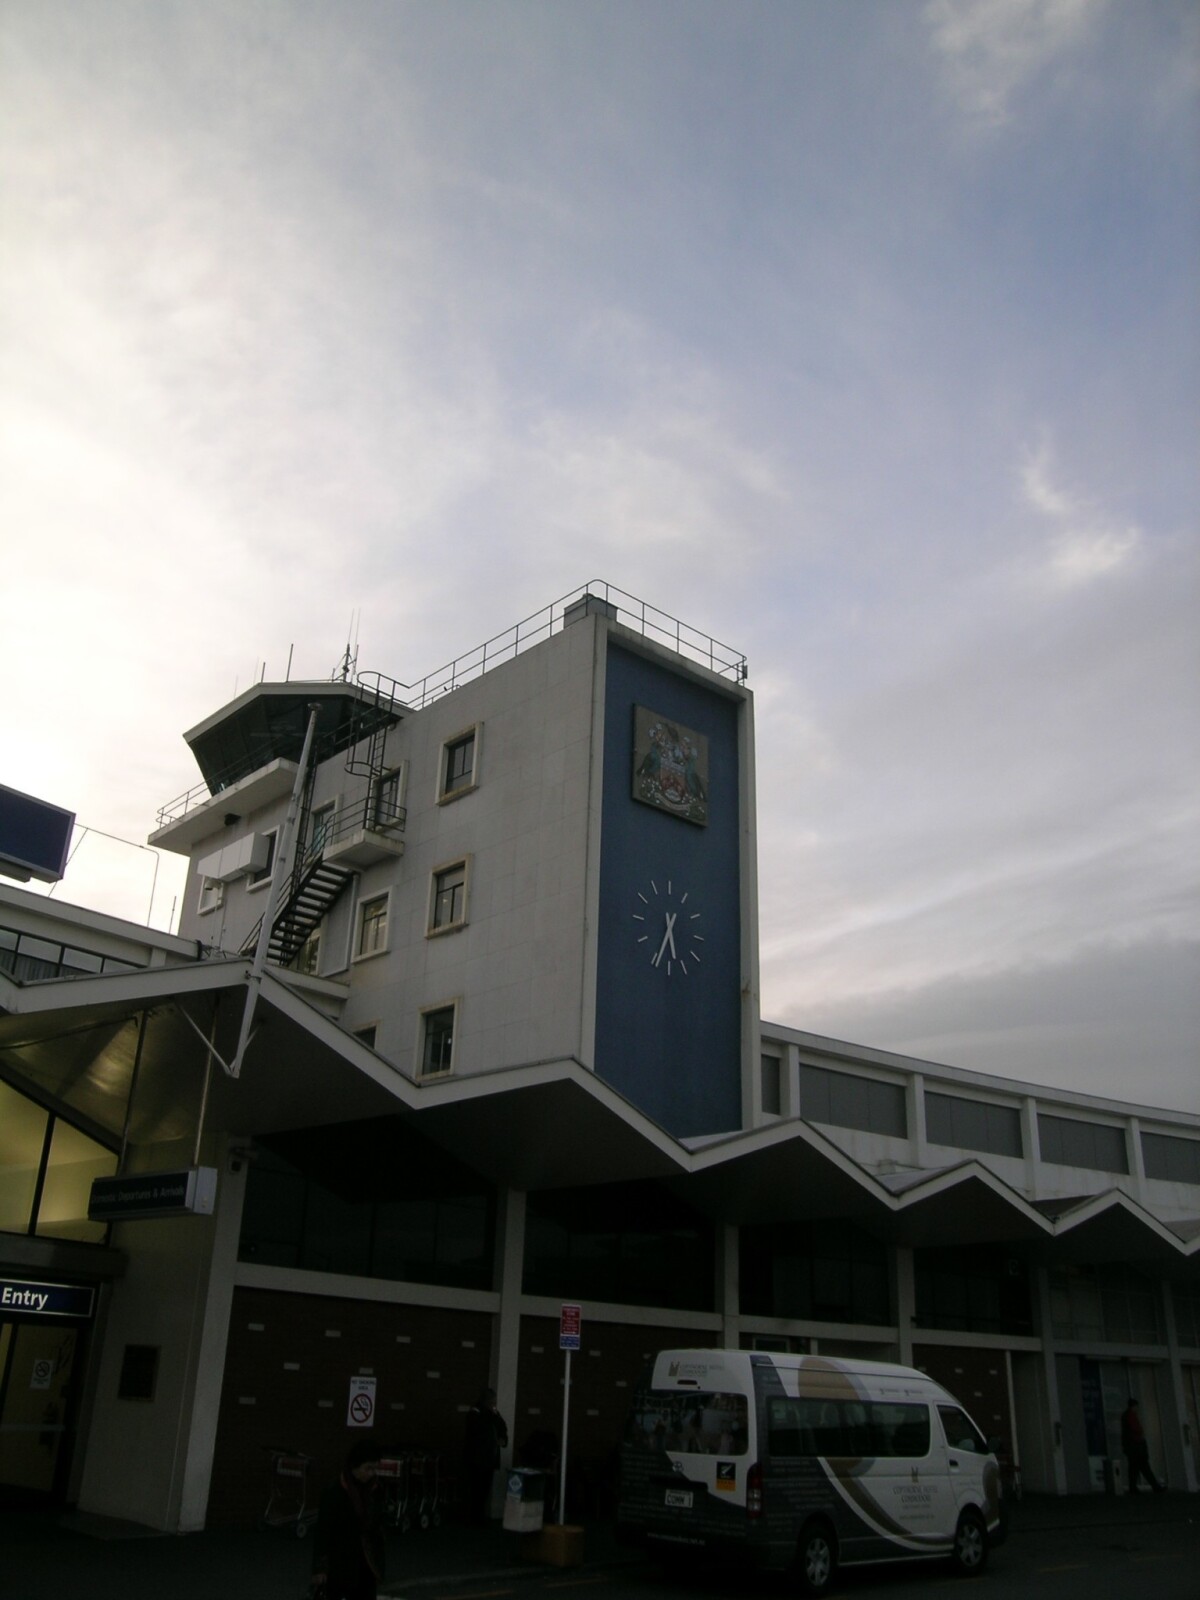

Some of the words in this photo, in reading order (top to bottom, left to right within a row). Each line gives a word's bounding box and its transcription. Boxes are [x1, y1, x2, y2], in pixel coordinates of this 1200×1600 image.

[118, 1190, 152, 1202] Departures
[153, 1187, 158, 1198] &
[160, 1185, 185, 1197] Arrivals
[1, 1287, 49, 1311] Entry
